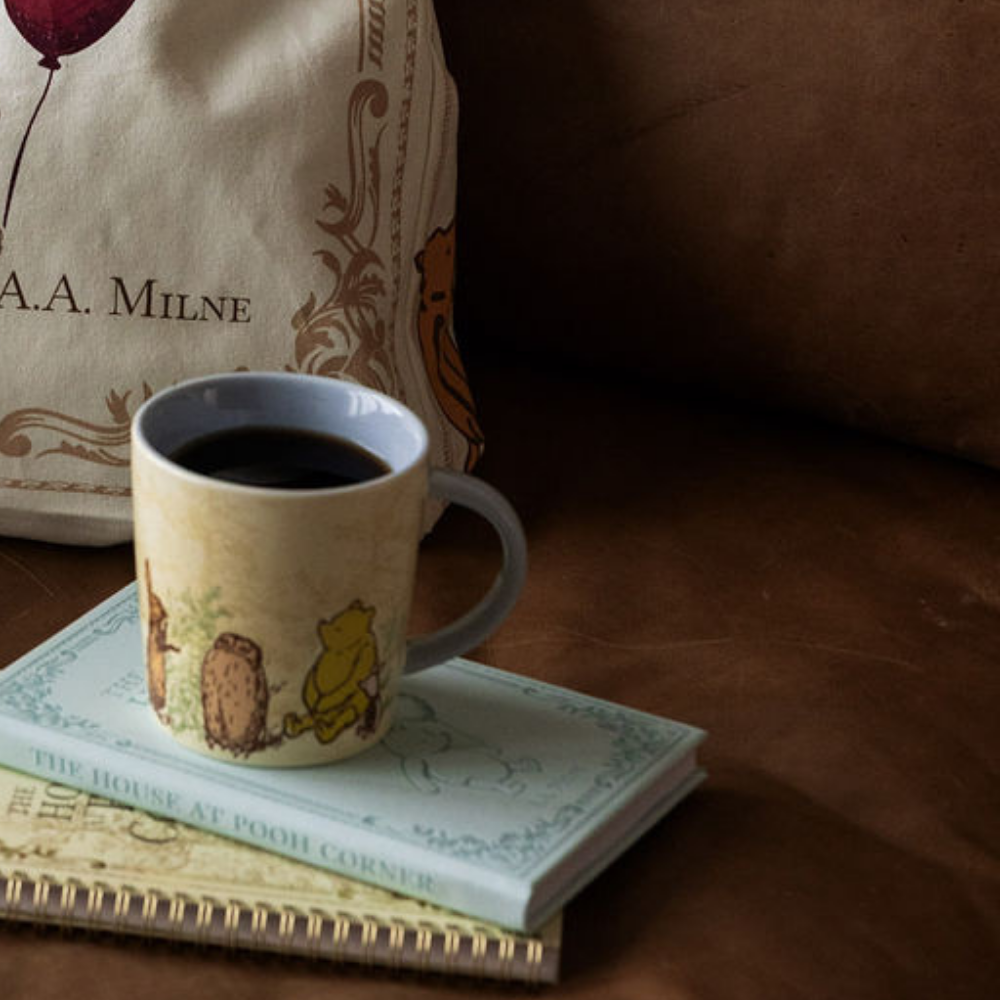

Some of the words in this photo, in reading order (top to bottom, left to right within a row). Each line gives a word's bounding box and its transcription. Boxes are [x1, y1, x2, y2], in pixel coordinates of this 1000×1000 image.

[108, 276, 252, 323] MILNE
[7, 785, 36, 817] THE
[30, 747, 83, 780] THE
[93, 768, 184, 813] HOUSE
[189, 801, 225, 825] AT
[233, 814, 311, 855] POOH
[320, 843, 439, 894] CORNER
